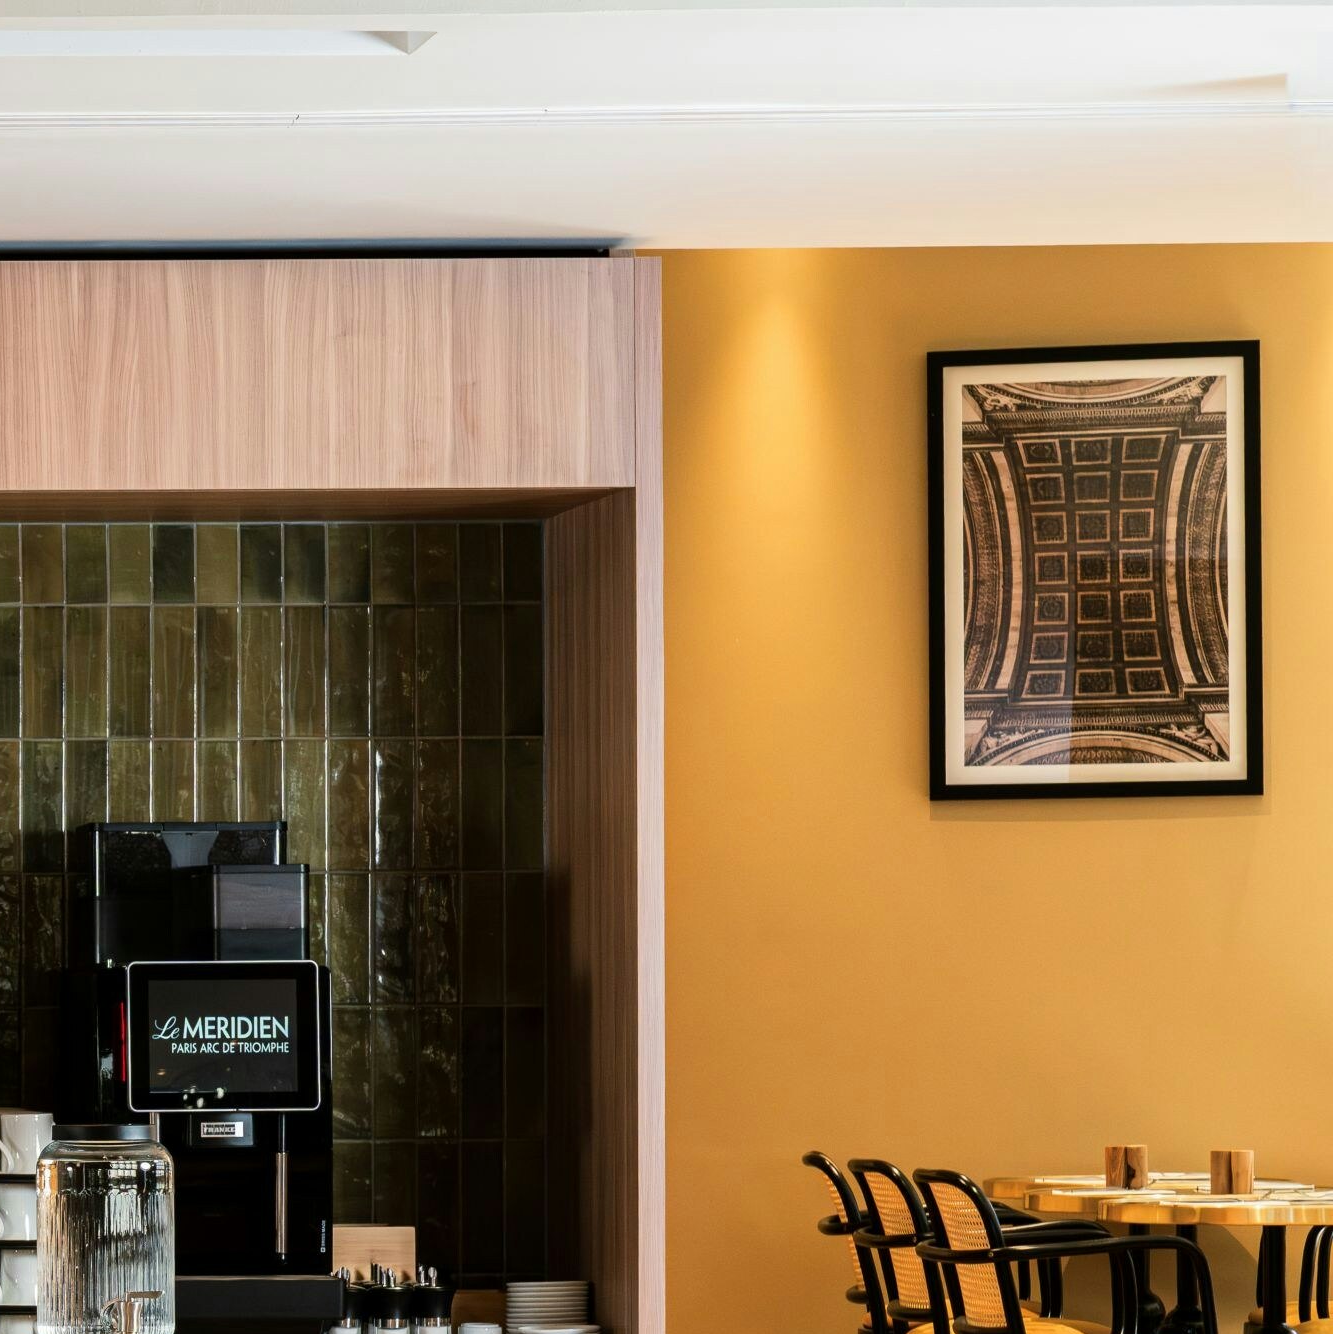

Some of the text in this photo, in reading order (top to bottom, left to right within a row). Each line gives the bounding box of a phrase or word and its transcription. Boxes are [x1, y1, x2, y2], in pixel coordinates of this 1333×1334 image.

[152, 1016, 289, 1039] Le MERIDIEN
[172, 1042, 289, 1053] PARIS ARC DE TRIOMPHE
